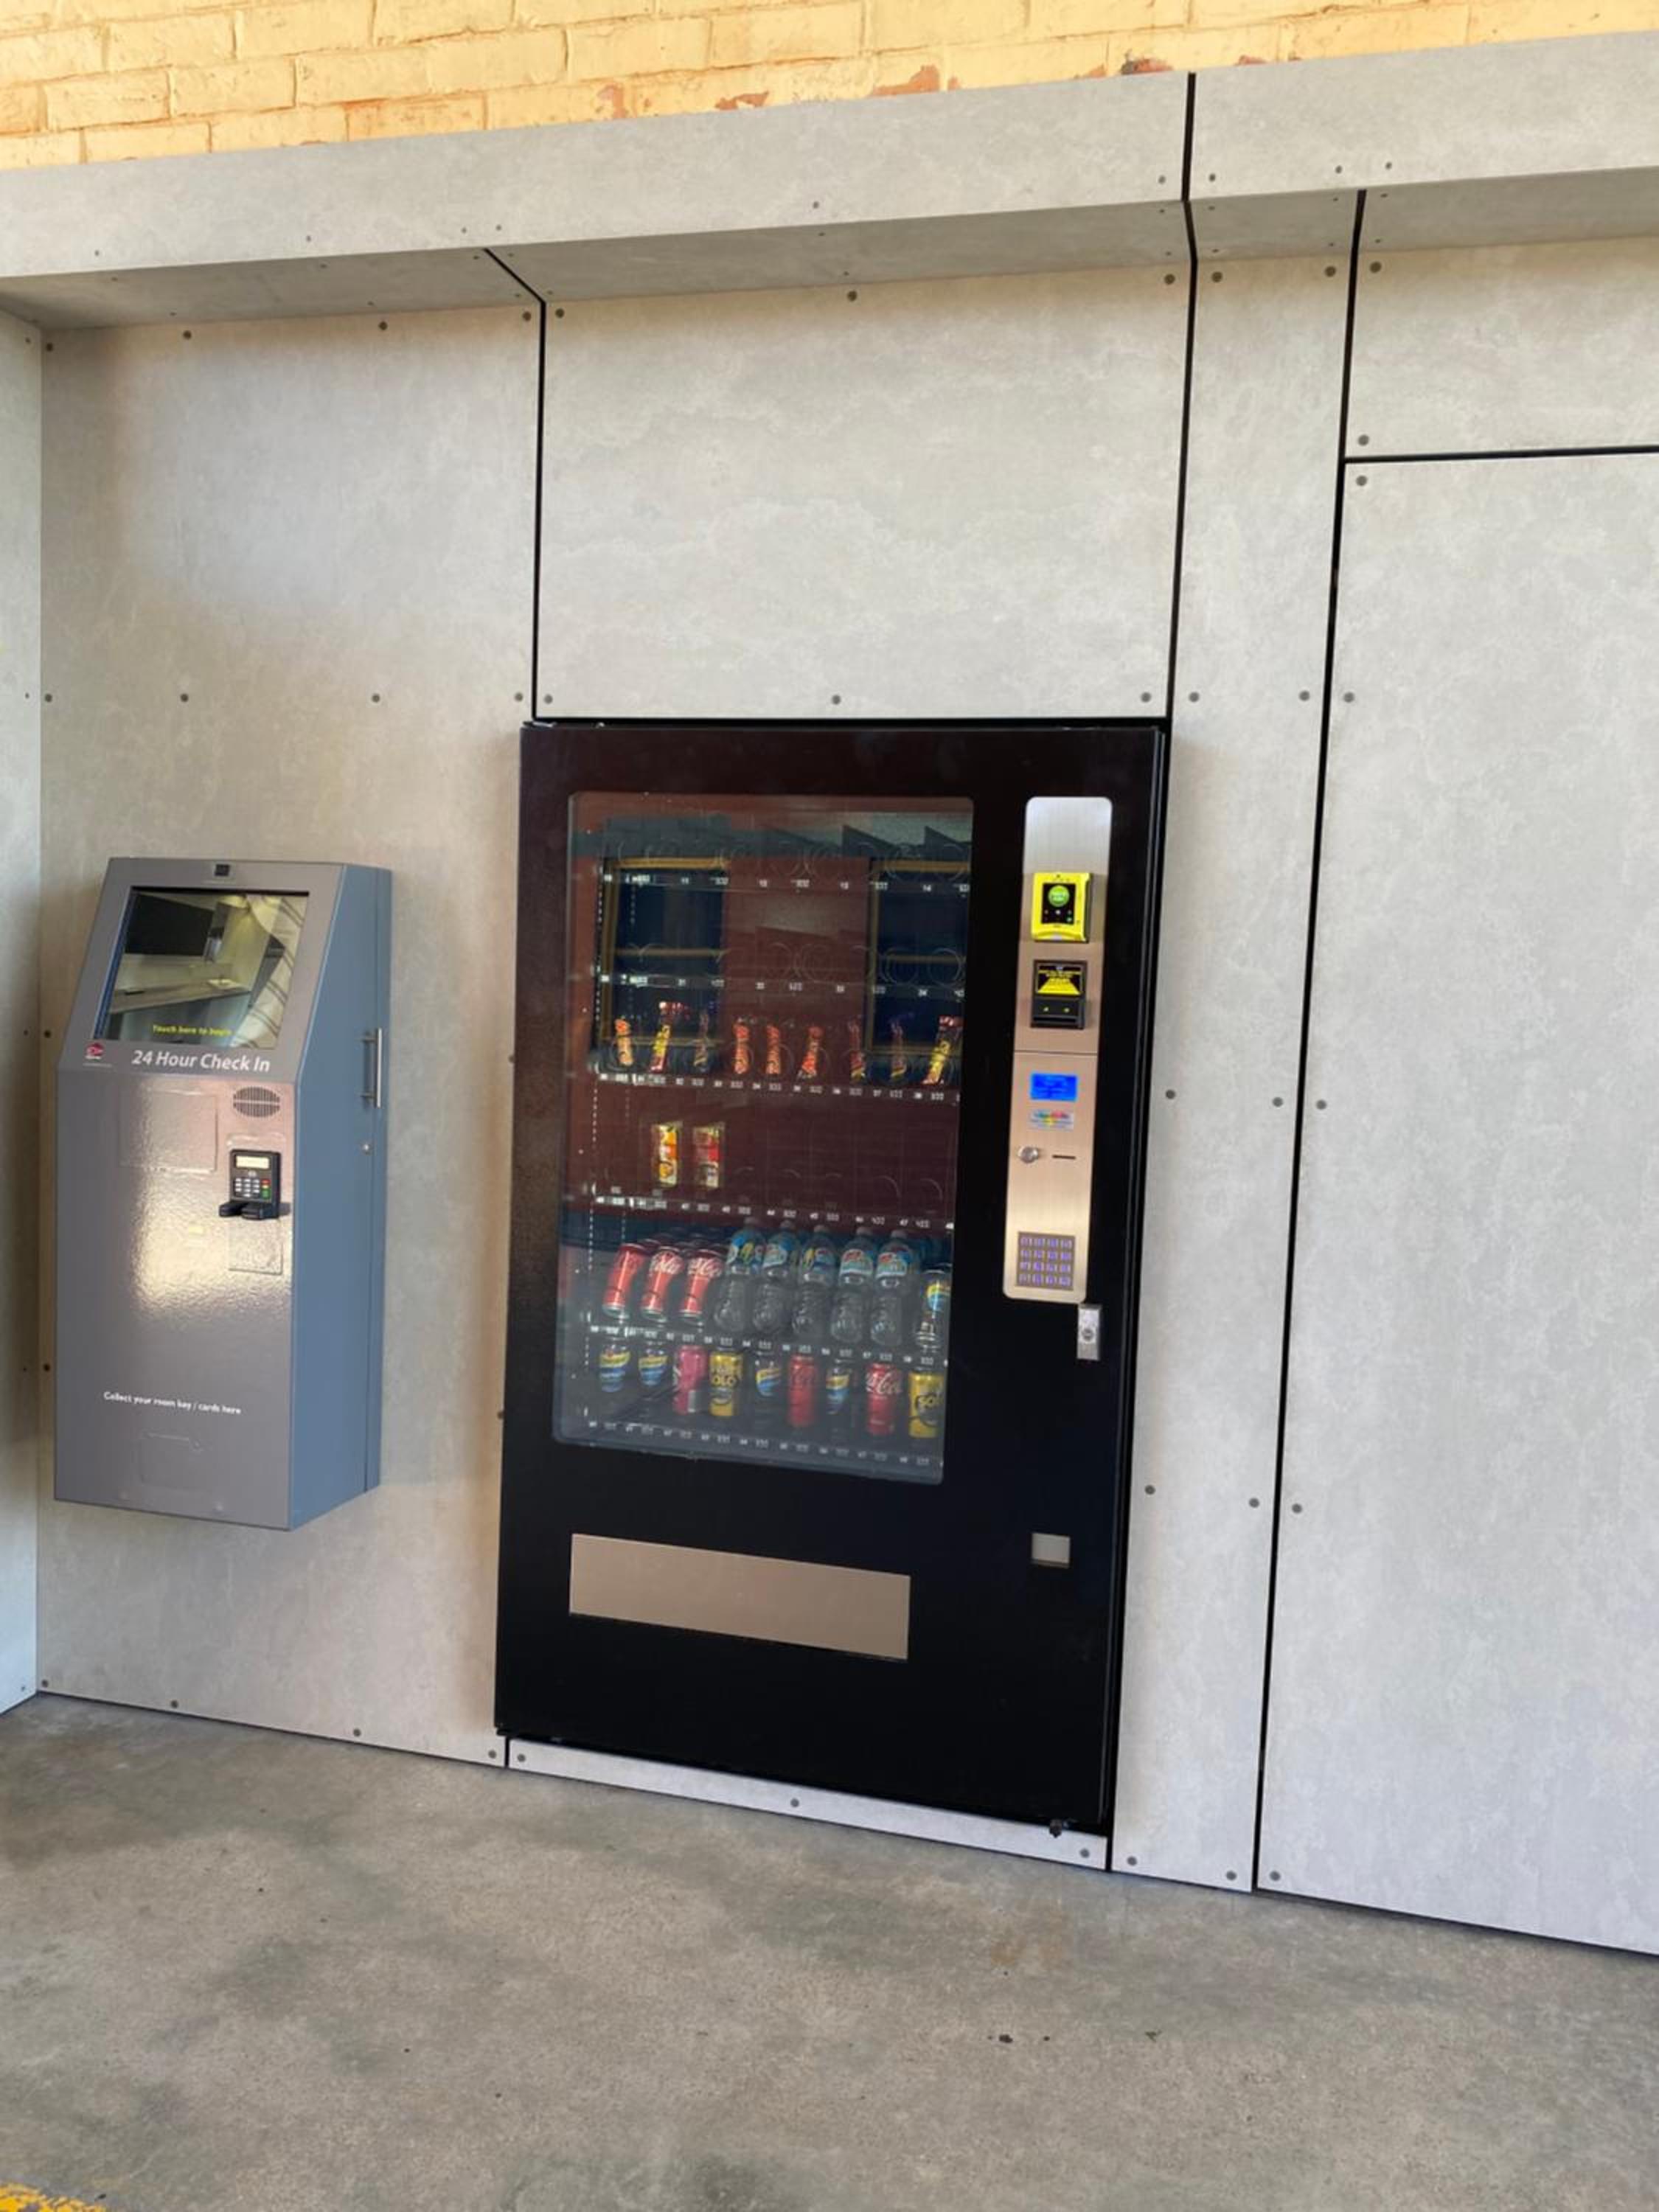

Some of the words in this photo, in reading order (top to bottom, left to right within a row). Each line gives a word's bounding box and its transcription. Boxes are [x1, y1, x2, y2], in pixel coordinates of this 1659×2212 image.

[178, 1026, 197, 1034] here
[132, 1050, 153, 1065] 24
[156, 1051, 198, 1068] Hour
[200, 1054, 251, 1071] Check
[254, 1056, 271, 1073] In
[103, 1391, 132, 1403] Collect
[133, 1396, 151, 1405] your
[153, 1398, 175, 1408] room
[177, 1399, 191, 1411] key
[198, 1403, 220, 1413] cards
[222, 1405, 241, 1415] here
